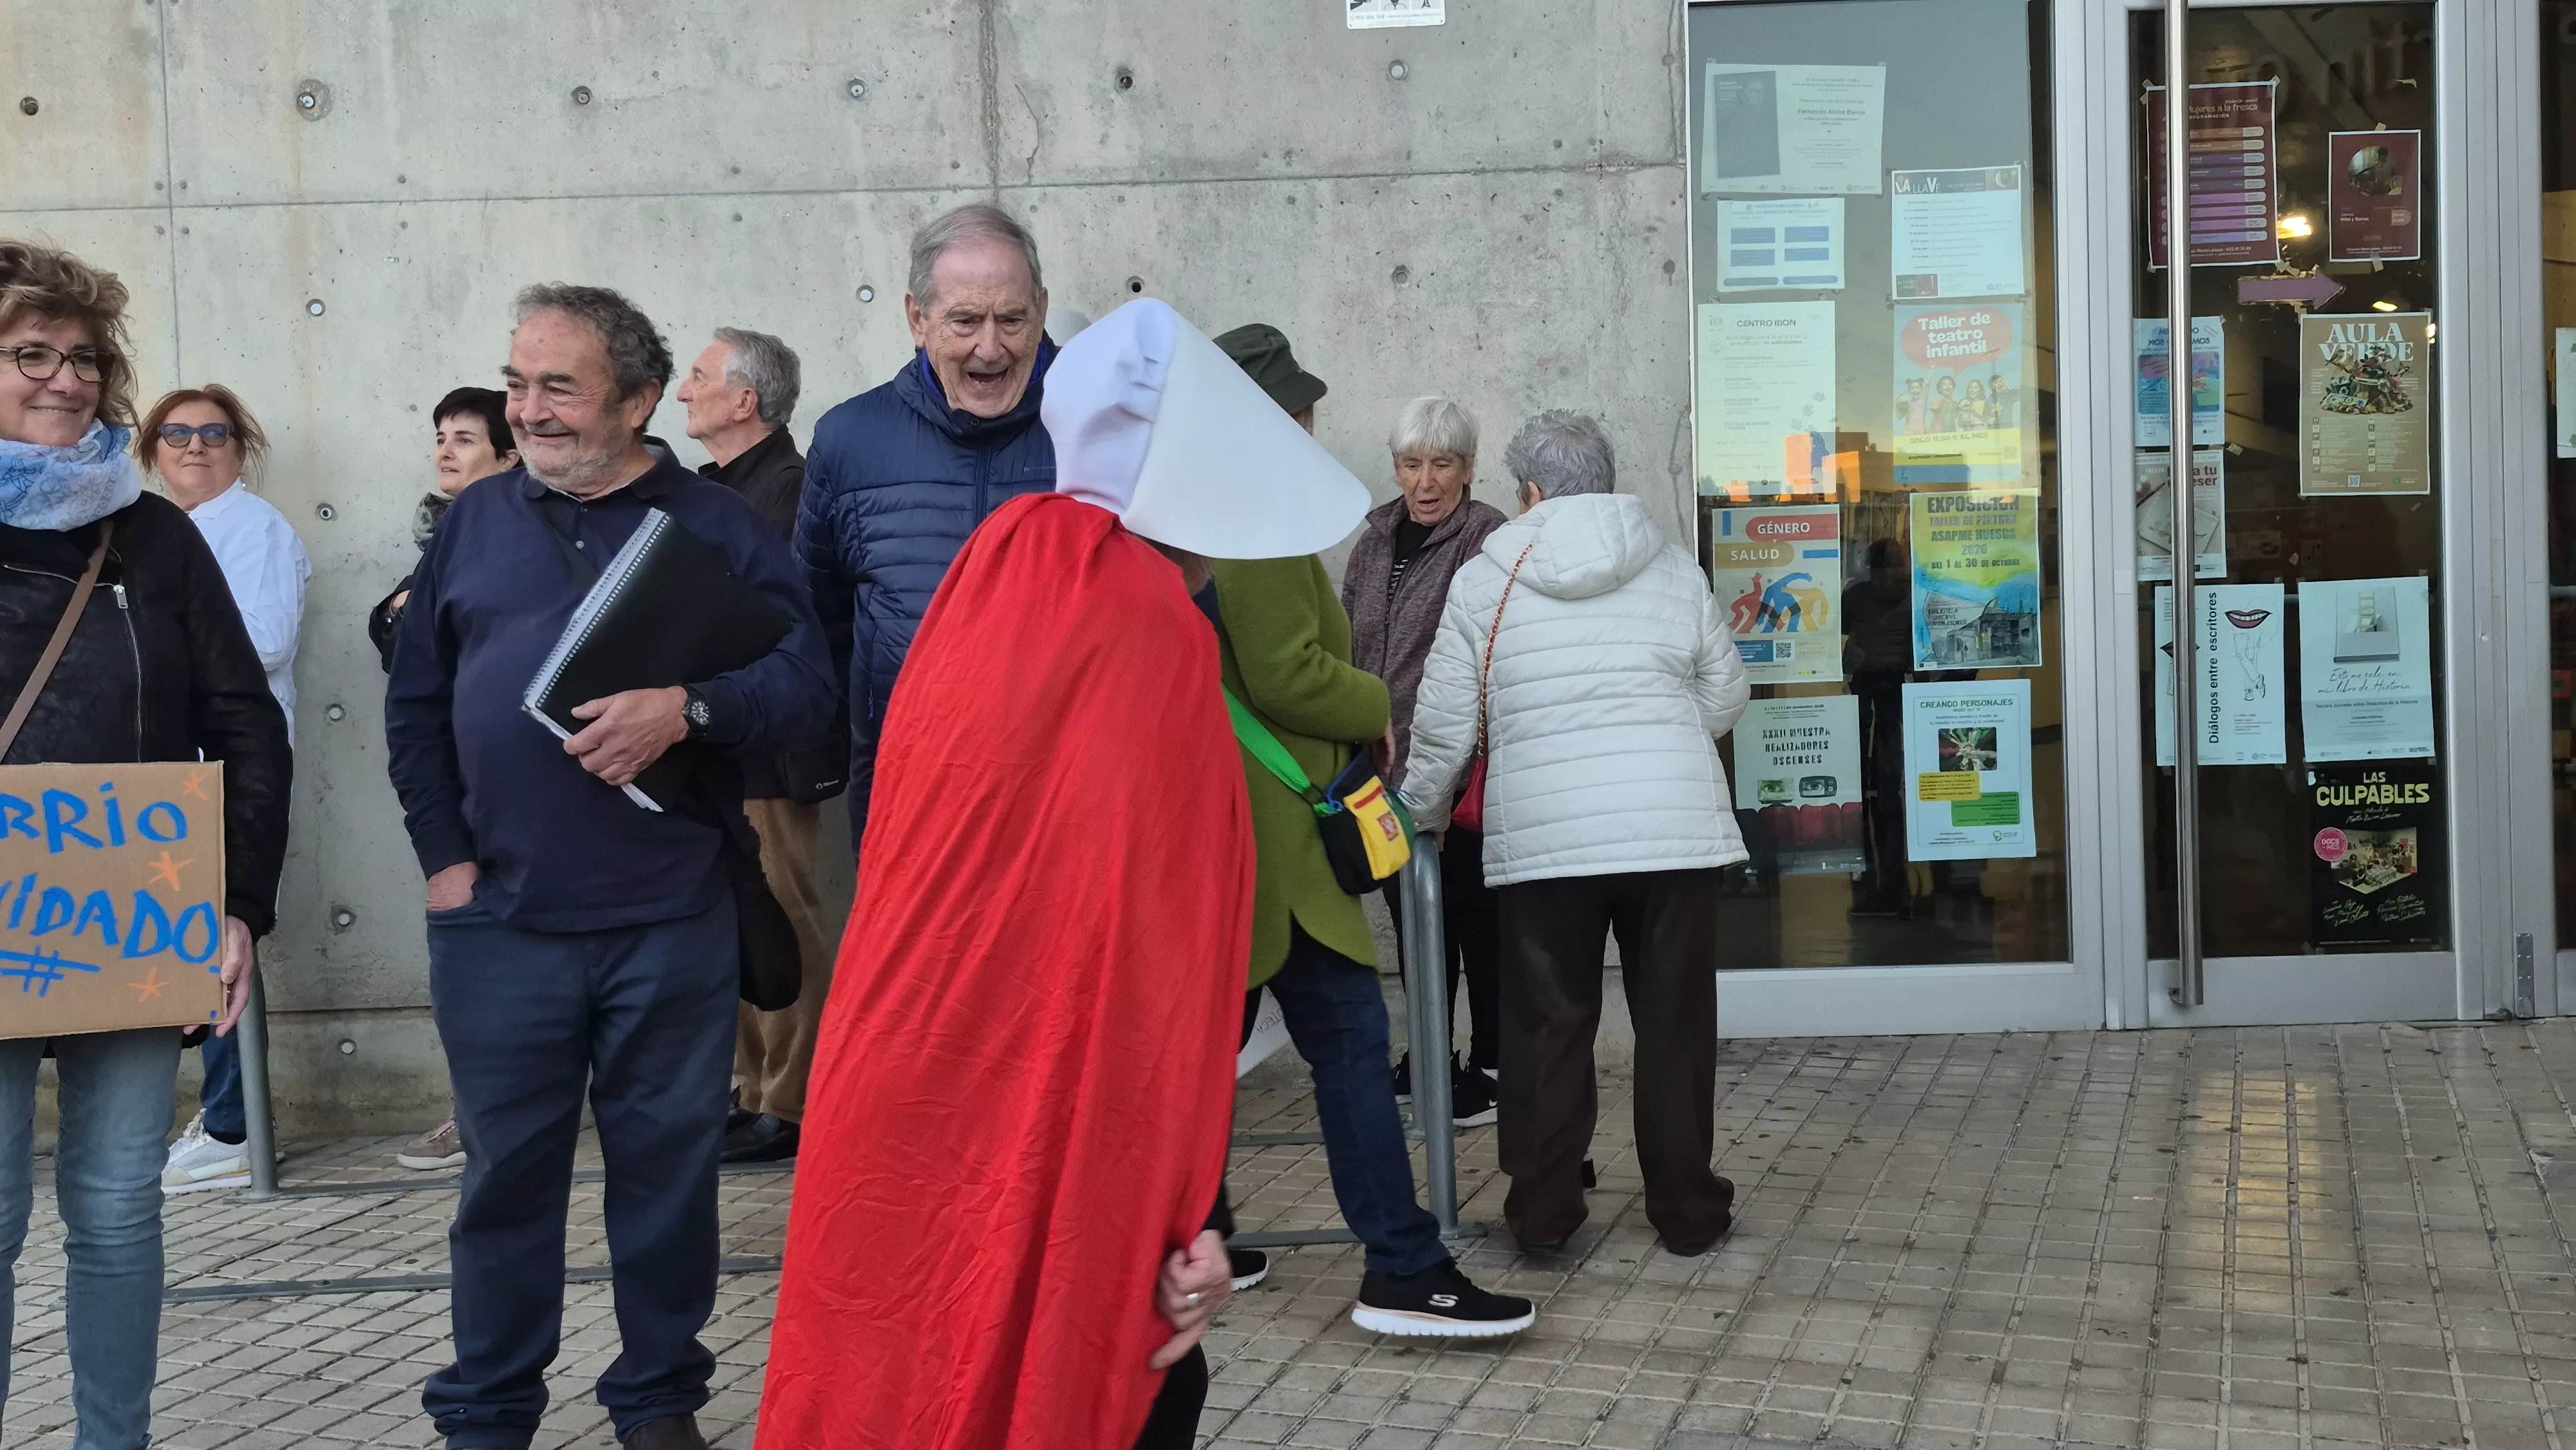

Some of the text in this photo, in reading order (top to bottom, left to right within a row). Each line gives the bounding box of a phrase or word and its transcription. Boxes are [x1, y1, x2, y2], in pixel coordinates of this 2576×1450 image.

[1918, 312, 1991, 331] Taller de
[1928, 329, 1983, 344] teatro
[2325, 323, 2405, 343] AULA
[1926, 340, 1987, 358] infantil
[2318, 342, 2414, 362] VERDE
[2202, 466, 2217, 475] tu
[1757, 521, 1810, 534] GÉNERO
[1975, 528, 2016, 540] HUESCA
[1731, 549, 1779, 561] SALUD
[1965, 558, 1978, 567] 30
[2206, 592, 2221, 744] Diálogos entre escritores
[2336, 679, 2358, 693] libro
[2372, 677, 2413, 693] Historia
[1920, 699, 2013, 709] CREANDO PERSONAJES
[1763, 727, 1830, 739] XXXII MUESTRA
[1765, 740, 1829, 752] REALIZADORES
[1773, 755, 1822, 766] OSCENSES
[2363, 772, 2386, 784] LAS
[2316, 784, 2430, 806] CULPABLES
